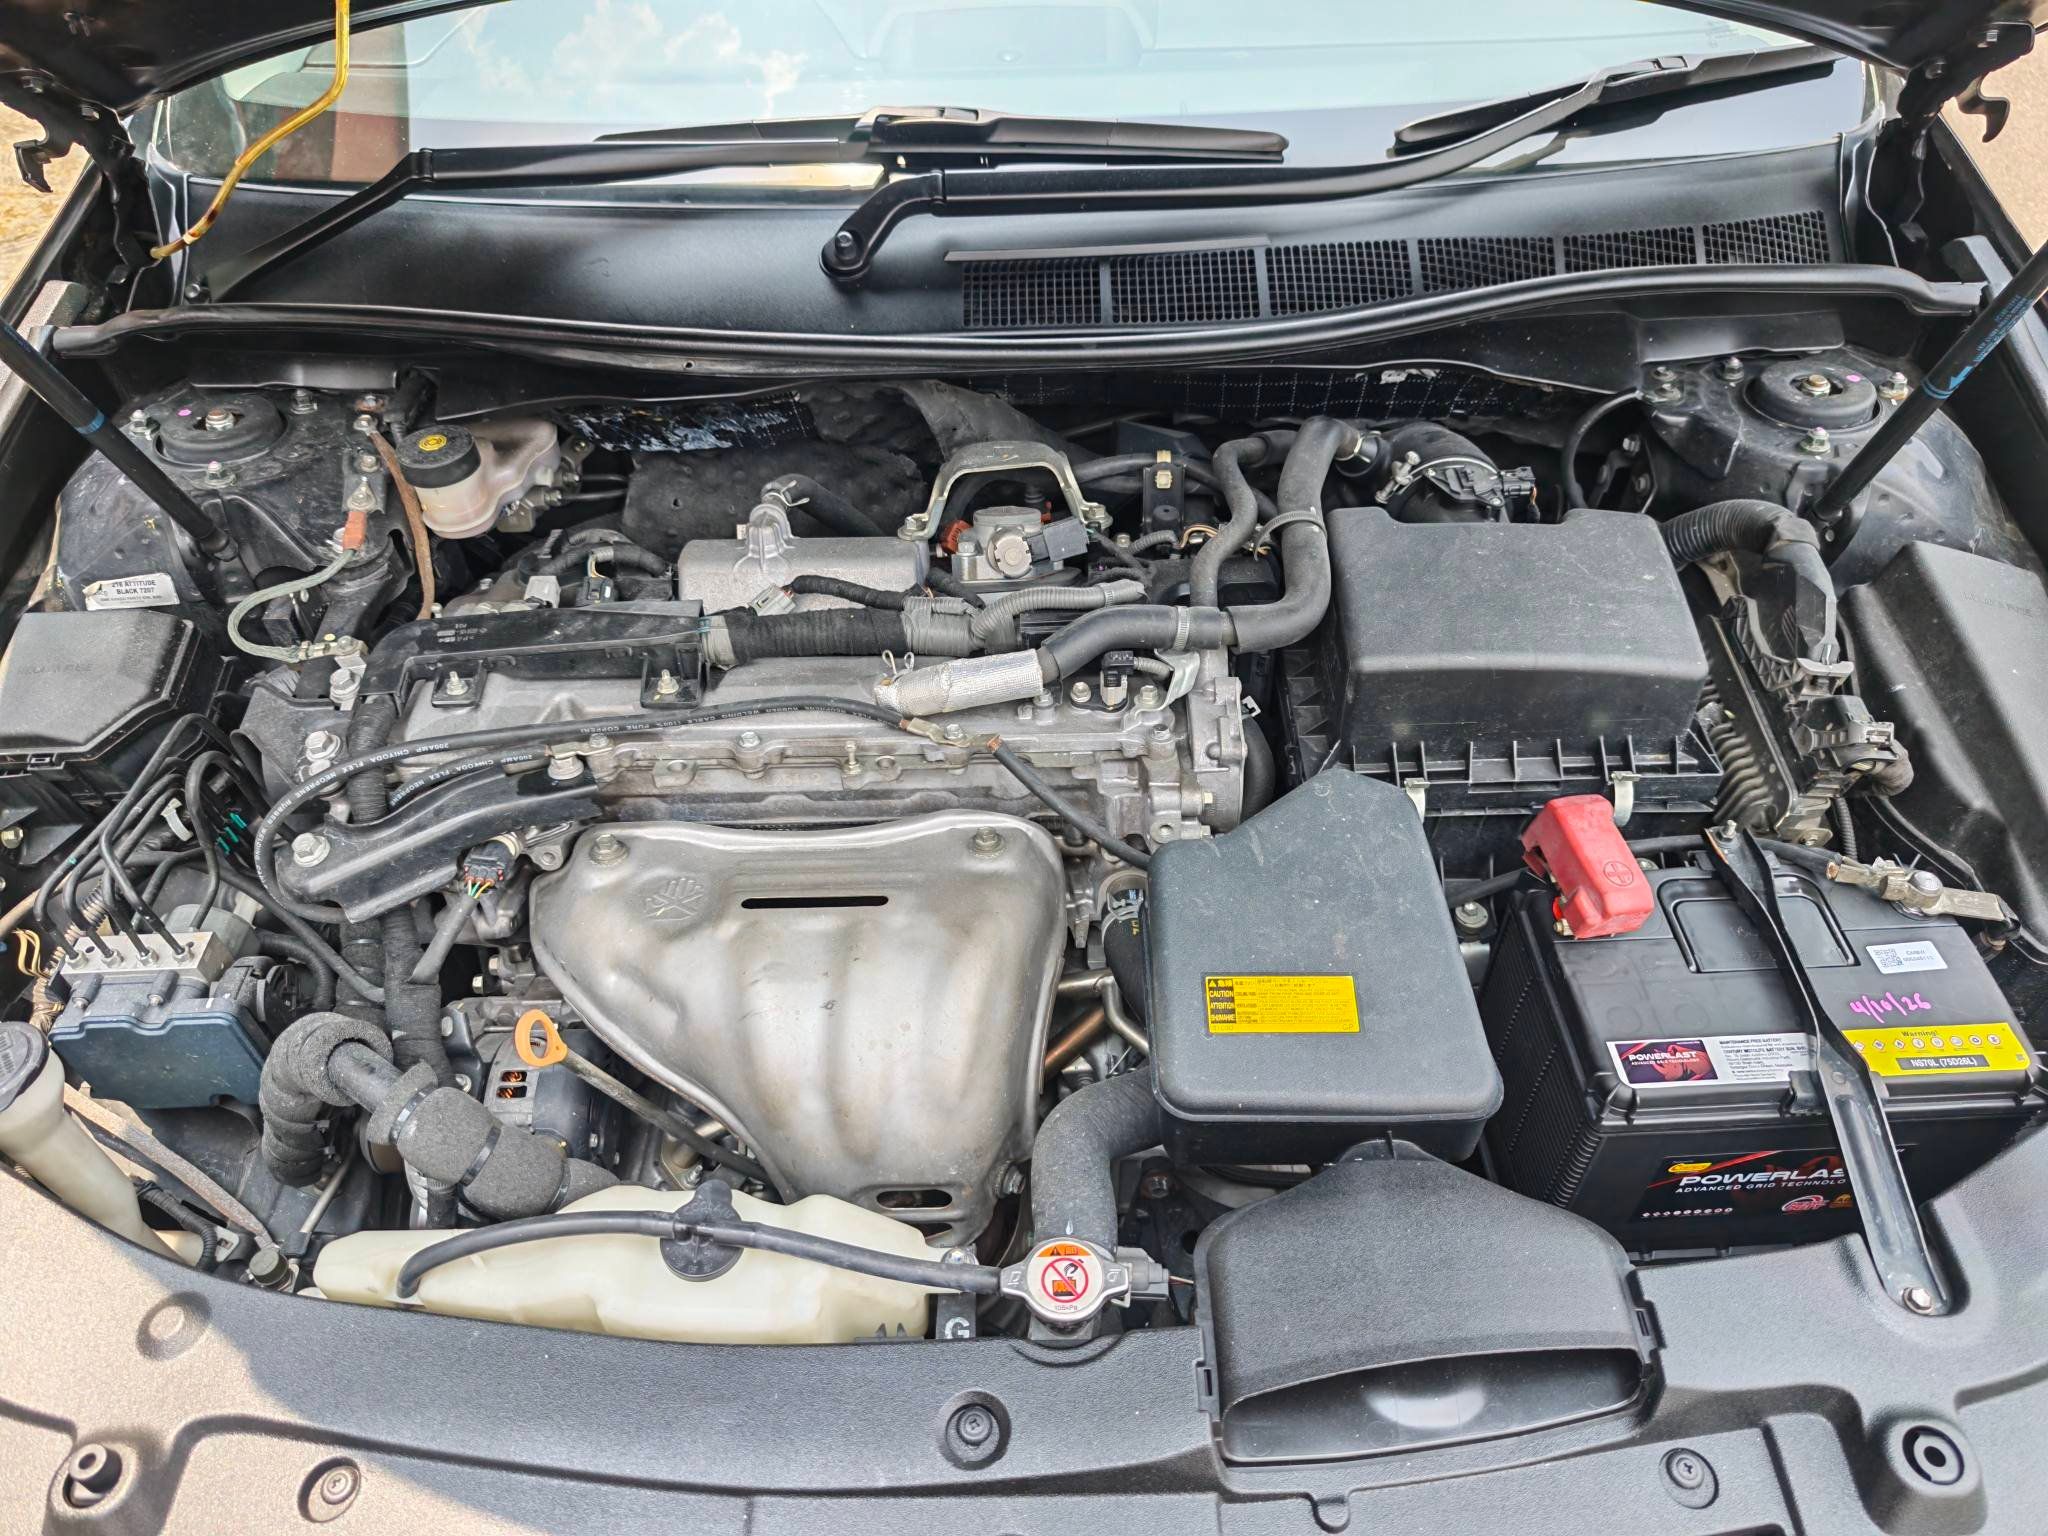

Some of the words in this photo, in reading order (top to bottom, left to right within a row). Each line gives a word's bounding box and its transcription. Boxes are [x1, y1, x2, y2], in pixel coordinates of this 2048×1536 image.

[416, 743, 449, 752] 200AMP
[369, 748, 410, 763] CHIYODA
[500, 754, 533, 763] 200AMP
[341, 760, 364, 773] FLEX
[428, 769, 450, 781] FLEX
[294, 771, 337, 799] NEOPRENE
[389, 779, 425, 807] NEOPRENE
[266, 798, 292, 826] RUBBER
[1209, 990, 1234, 999] CAUTION
[1210, 1002, 1235, 1010] ATTENTION
[1901, 1029, 1938, 1037] Warning!
[1628, 1051, 1698, 1061] POWERLAST
[1911, 1058, 1938, 1067] NS70L
[1675, 1184, 1742, 1194] ADVANCED
[1747, 1182, 1776, 1191] GRID
